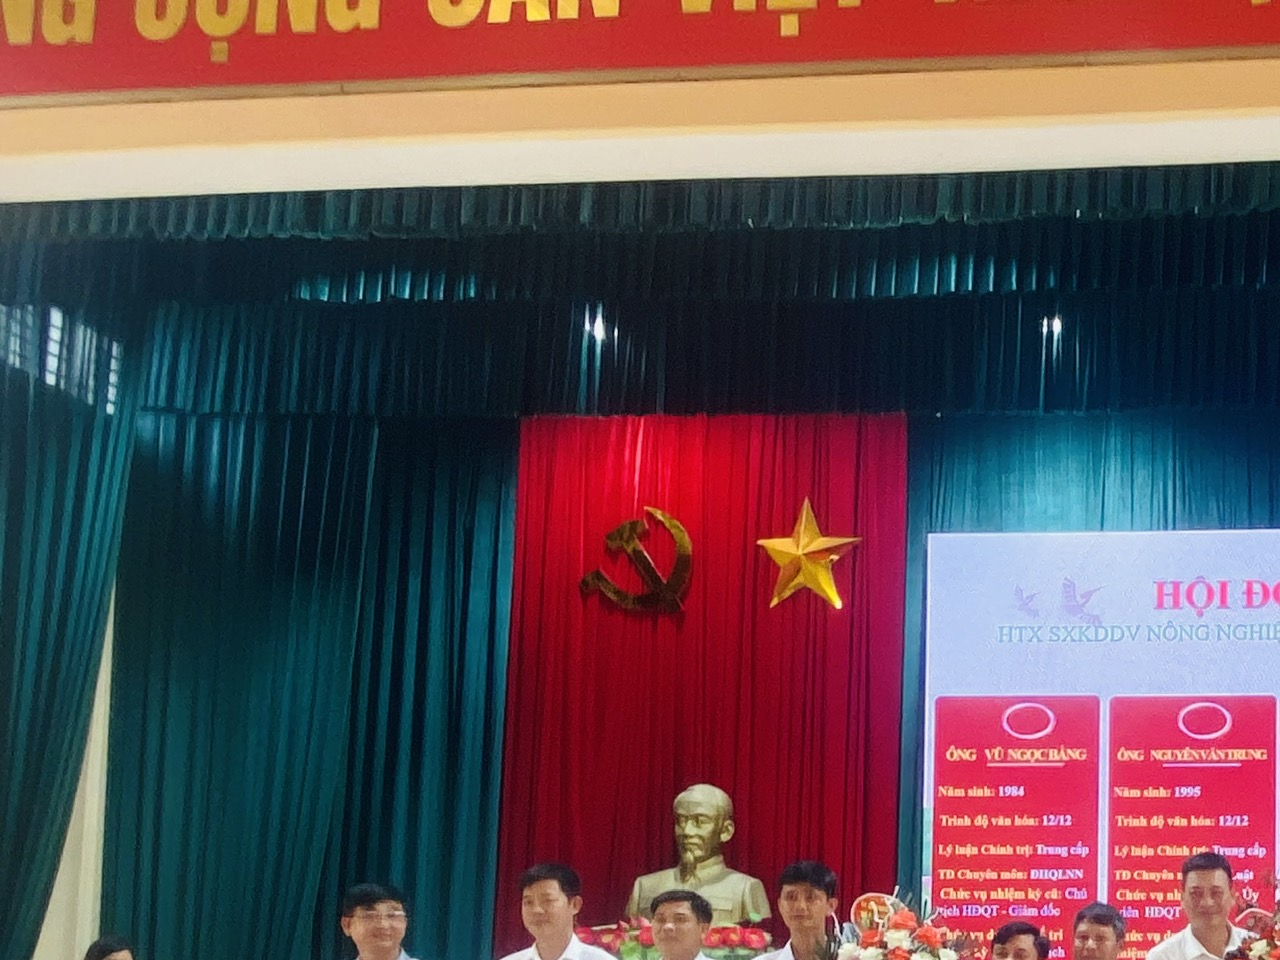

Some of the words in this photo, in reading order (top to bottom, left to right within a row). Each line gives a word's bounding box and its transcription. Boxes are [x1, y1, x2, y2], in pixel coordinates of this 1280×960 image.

[1153, 574, 1231, 618] HỘI
[998, 625, 1043, 643] HTX
[1146, 620, 1210, 642] NÔNG
[946, 745, 976, 761] ÔNG
[1117, 747, 1144, 761] ÔNG
[938, 786, 965, 797] Năm
[968, 786, 995, 797] sinh:
[999, 786, 1024, 797] 1984
[1114, 786, 1140, 798] Năm
[1143, 787, 1171, 797] sinh:
[1174, 787, 1201, 797] 1995
[974, 815, 988, 828] độ
[992, 816, 1011, 826] văn
[1042, 815, 1071, 826] 12/12
[1150, 816, 1164, 829] độ
[1167, 817, 1187, 827] văn
[1219, 815, 1248, 827] 12/12
[981, 844, 1013, 855] Chính
[1036, 844, 1068, 858] Trung
[1070, 841, 1089, 858] cấp
[1157, 845, 1189, 856] Chính
[1212, 844, 1245, 858] Trung
[1247, 842, 1266, 858] cấp
[958, 869, 998, 882] Chuyên
[1134, 870, 1175, 882] Chuyên
[974, 891, 987, 902] vụ
[990, 888, 1025, 901] nhiệm
[1150, 892, 1164, 903] vụ
[963, 905, 1000, 918] HĐQT
[1008, 905, 1038, 916] Giám
[1145, 907, 1182, 918] HĐQT
